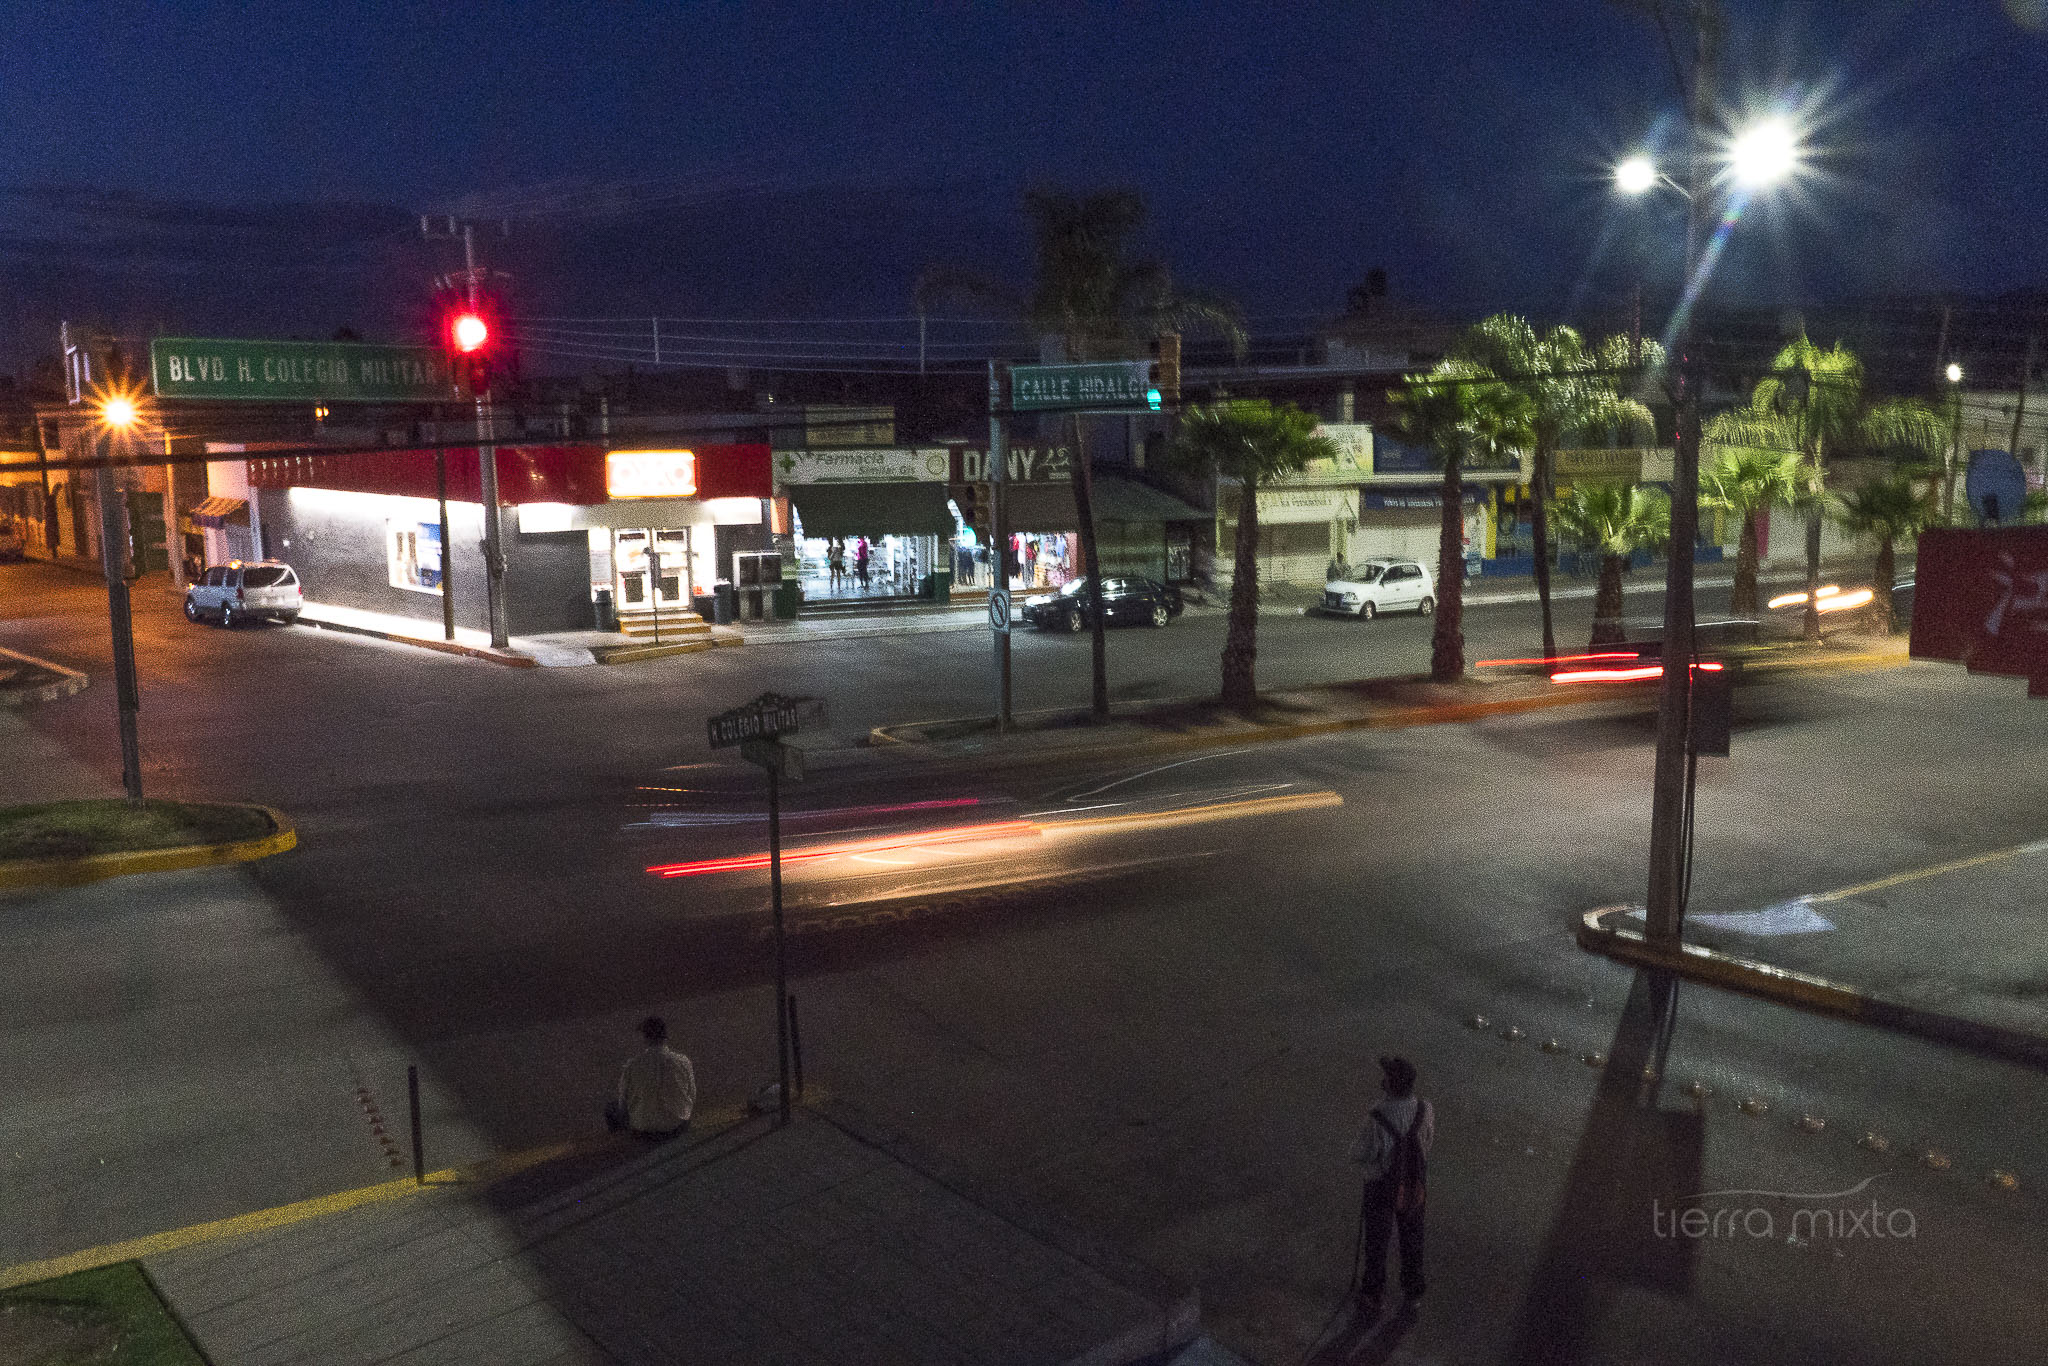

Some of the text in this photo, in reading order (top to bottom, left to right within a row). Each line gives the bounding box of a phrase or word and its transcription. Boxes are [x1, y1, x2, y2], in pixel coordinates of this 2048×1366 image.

[169, 355, 438, 385] BLVD. H. COLEGIO MILITAR
[1021, 375, 1150, 401] CALLE HIDALGO
[816, 453, 885, 465] Farmacia
[858, 466, 895, 475] Similar
[963, 448, 1036, 482] DANY
[721, 715, 760, 740] COLEGIO
